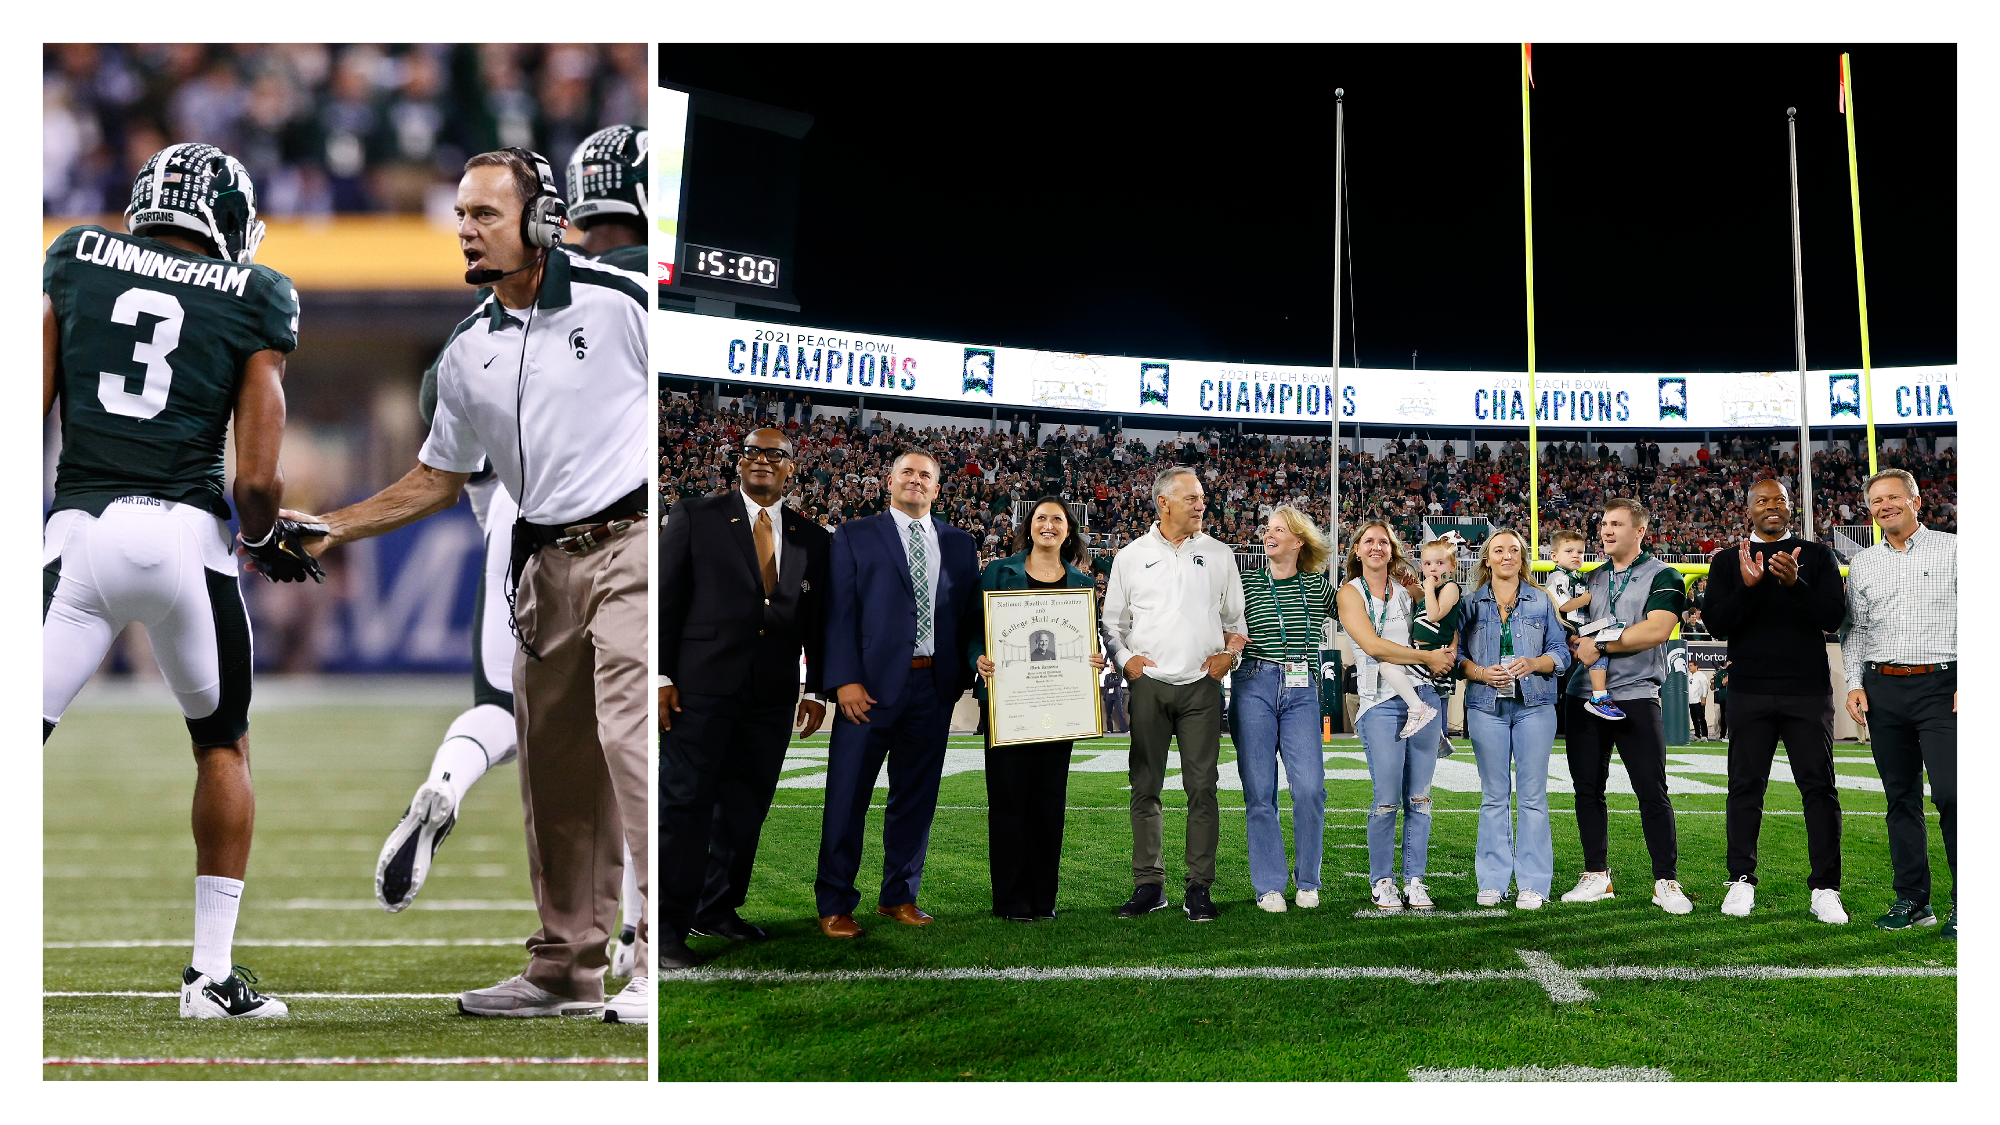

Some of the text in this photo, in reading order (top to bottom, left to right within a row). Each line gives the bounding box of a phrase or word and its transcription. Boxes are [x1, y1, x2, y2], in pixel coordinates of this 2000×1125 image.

[135, 211, 174, 224] SPARTANS
[75, 230, 251, 297] CUNNINGHAM
[698, 251, 775, 284] 15:00
[97, 287, 185, 419] 3
[754, 329, 897, 355] 2021 PEACH BOWL
[728, 339, 917, 391] CHAMPIONS
[1220, 369, 1332, 383] 2021 PEACH BOW
[1917, 372, 1948, 383] 2021
[1200, 379, 1356, 417] CHAMPIONS
[1493, 378, 1611, 390] 2021 EACH BOWL
[1475, 389, 1630, 421] CHAMPIONS
[1896, 385, 1954, 417] CHA
[113, 496, 161, 507] PARTANS
